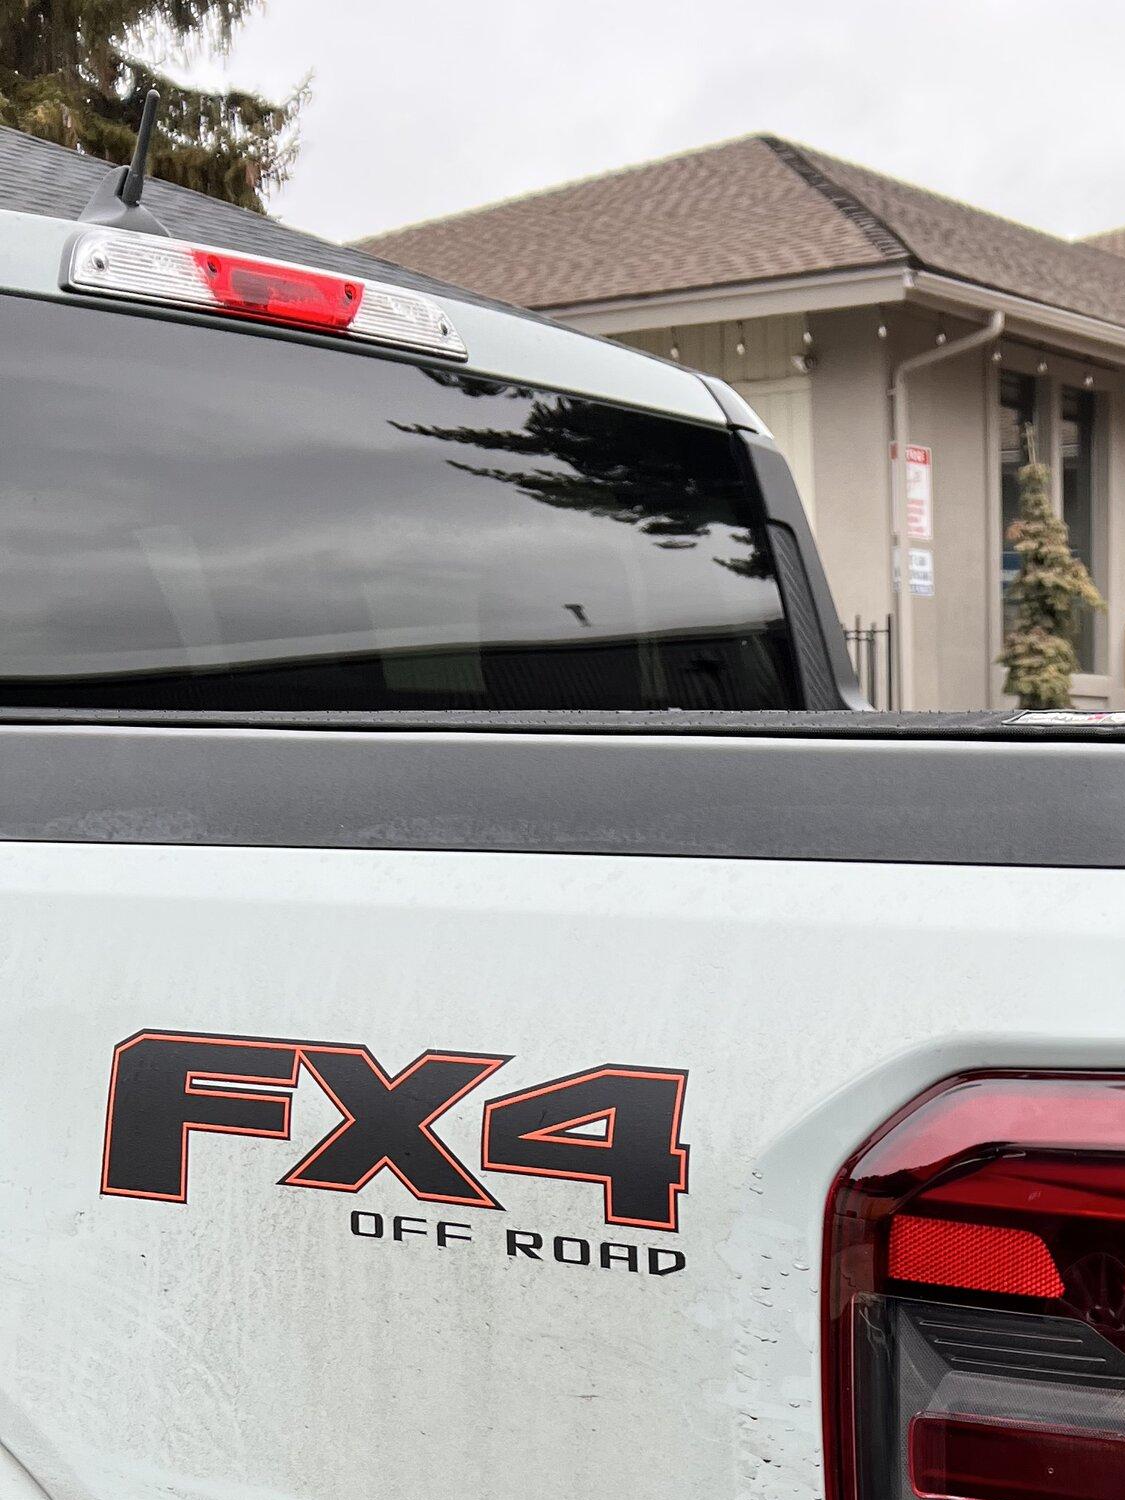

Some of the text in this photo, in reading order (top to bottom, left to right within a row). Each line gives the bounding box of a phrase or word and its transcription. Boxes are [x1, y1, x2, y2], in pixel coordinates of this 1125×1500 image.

[101, 1028, 691, 1233] FX4
[350, 1209, 687, 1276] OFF ROAD
